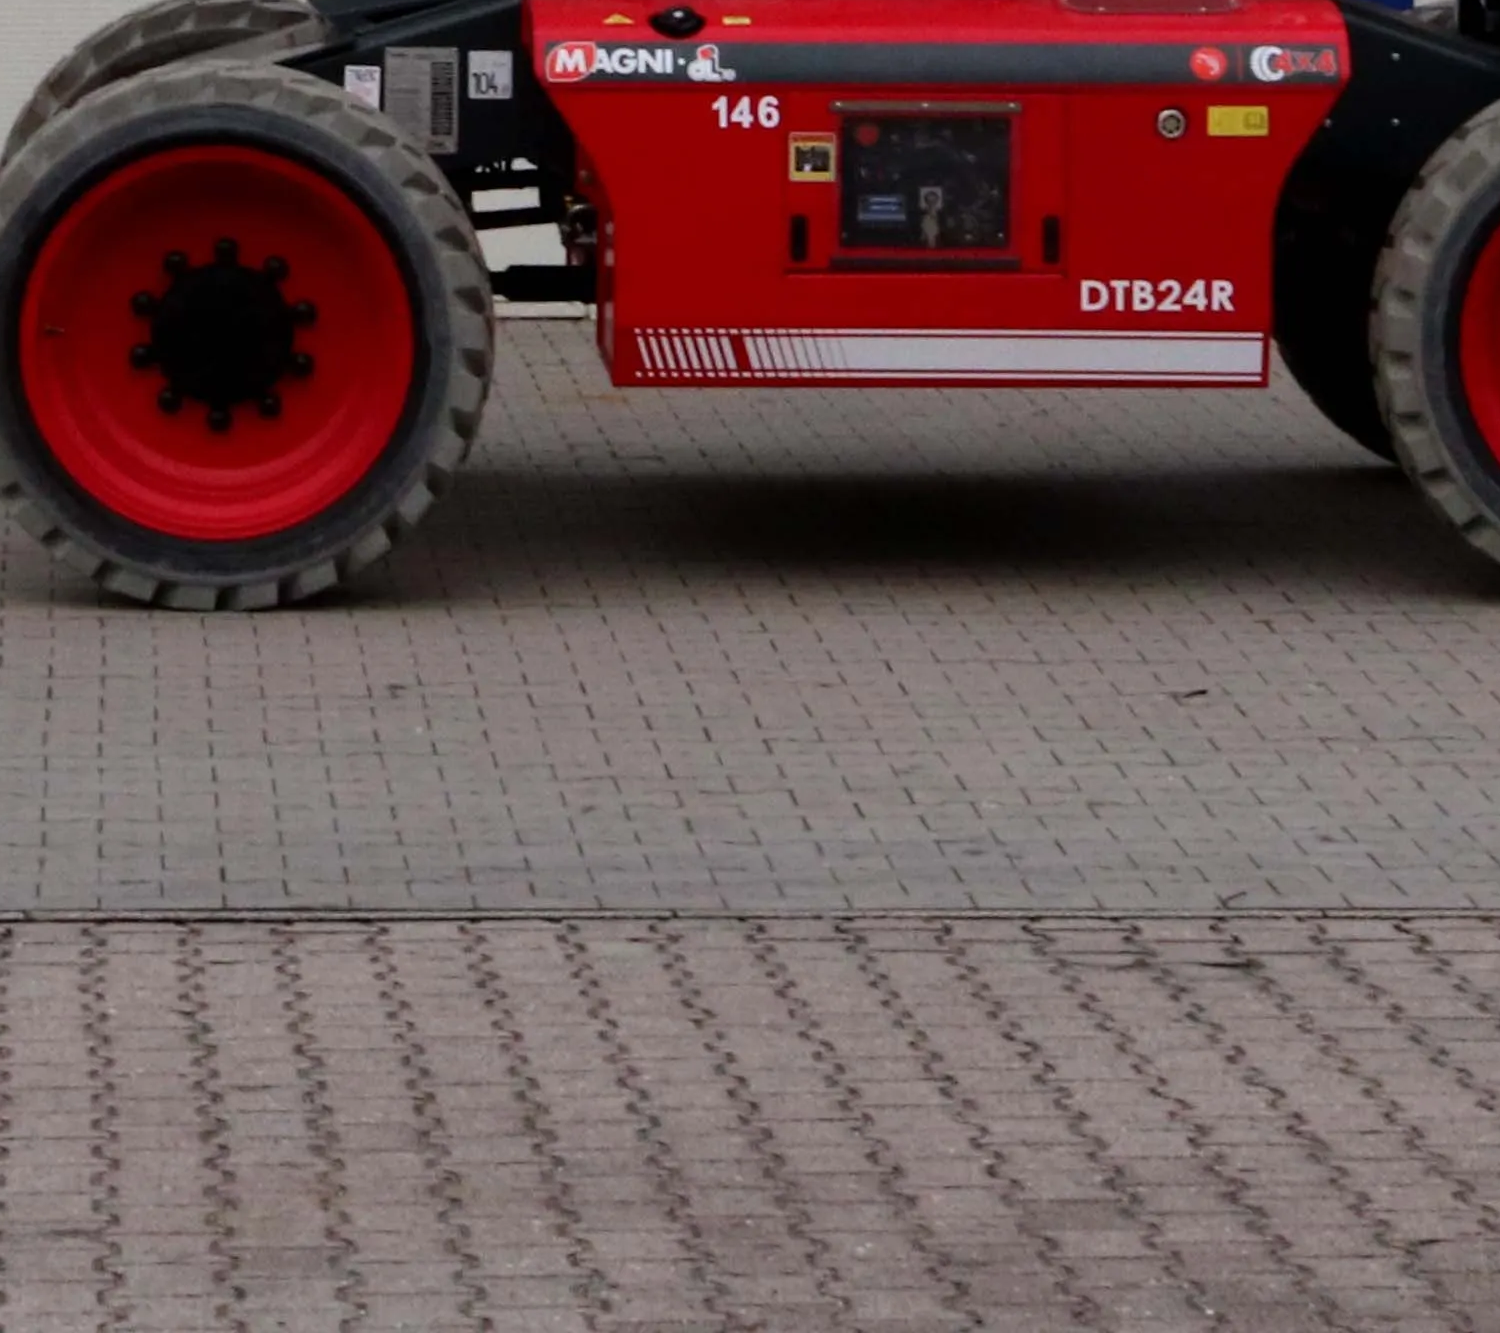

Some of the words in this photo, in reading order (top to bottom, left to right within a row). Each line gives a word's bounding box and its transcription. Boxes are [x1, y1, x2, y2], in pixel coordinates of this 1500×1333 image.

[553, 46, 674, 75] MAGNI
[712, 95, 780, 128] 146
[1080, 279, 1235, 312] DTB24R
